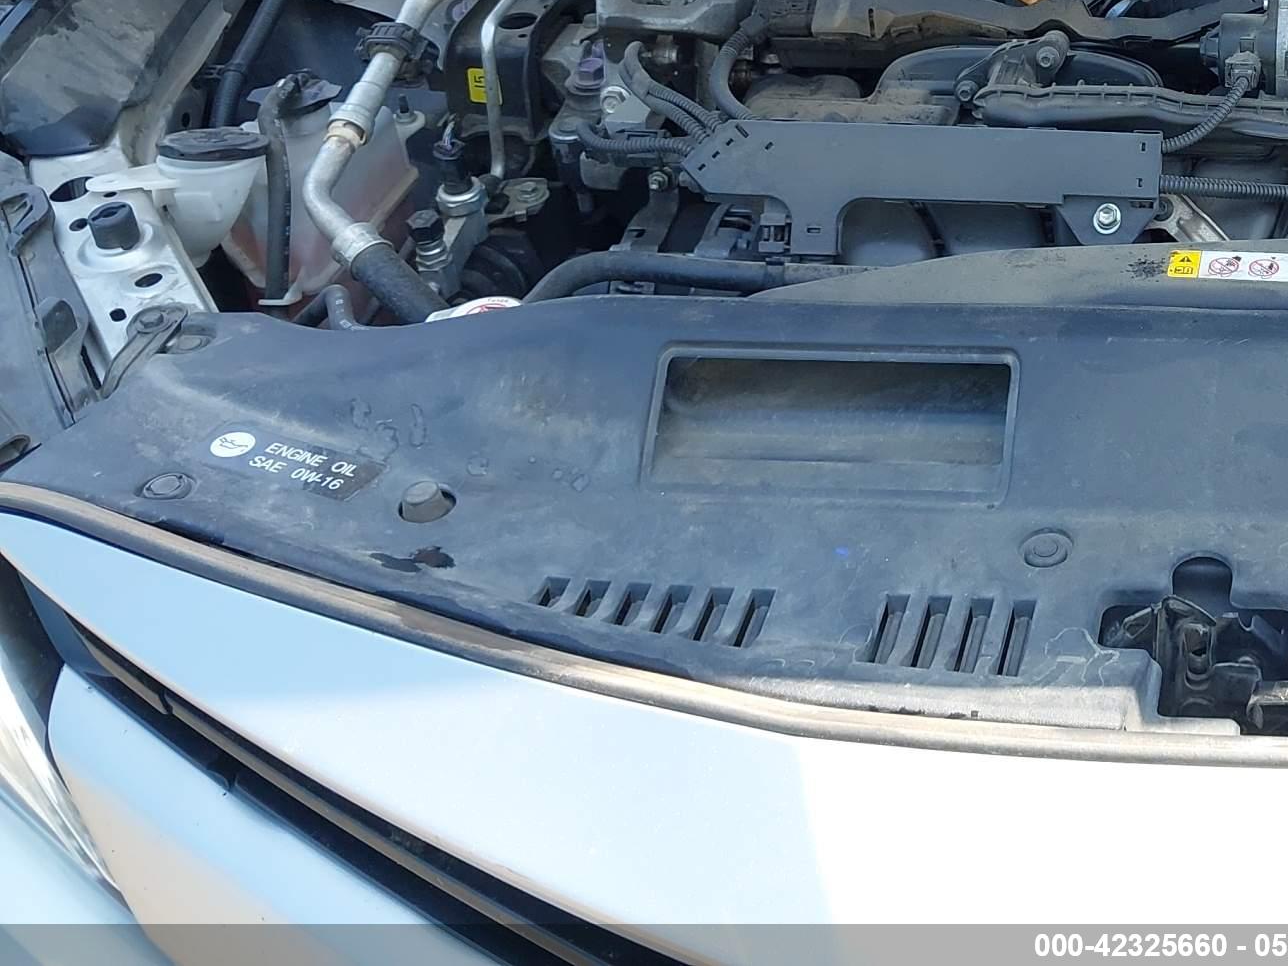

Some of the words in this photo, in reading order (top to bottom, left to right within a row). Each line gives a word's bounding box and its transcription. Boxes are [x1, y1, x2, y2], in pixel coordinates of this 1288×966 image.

[249, 455, 287, 473] SAE
[290, 467, 344, 490] 0W-16
[265, 442, 328, 467] ENGINE
[331, 461, 357, 477] OIL
